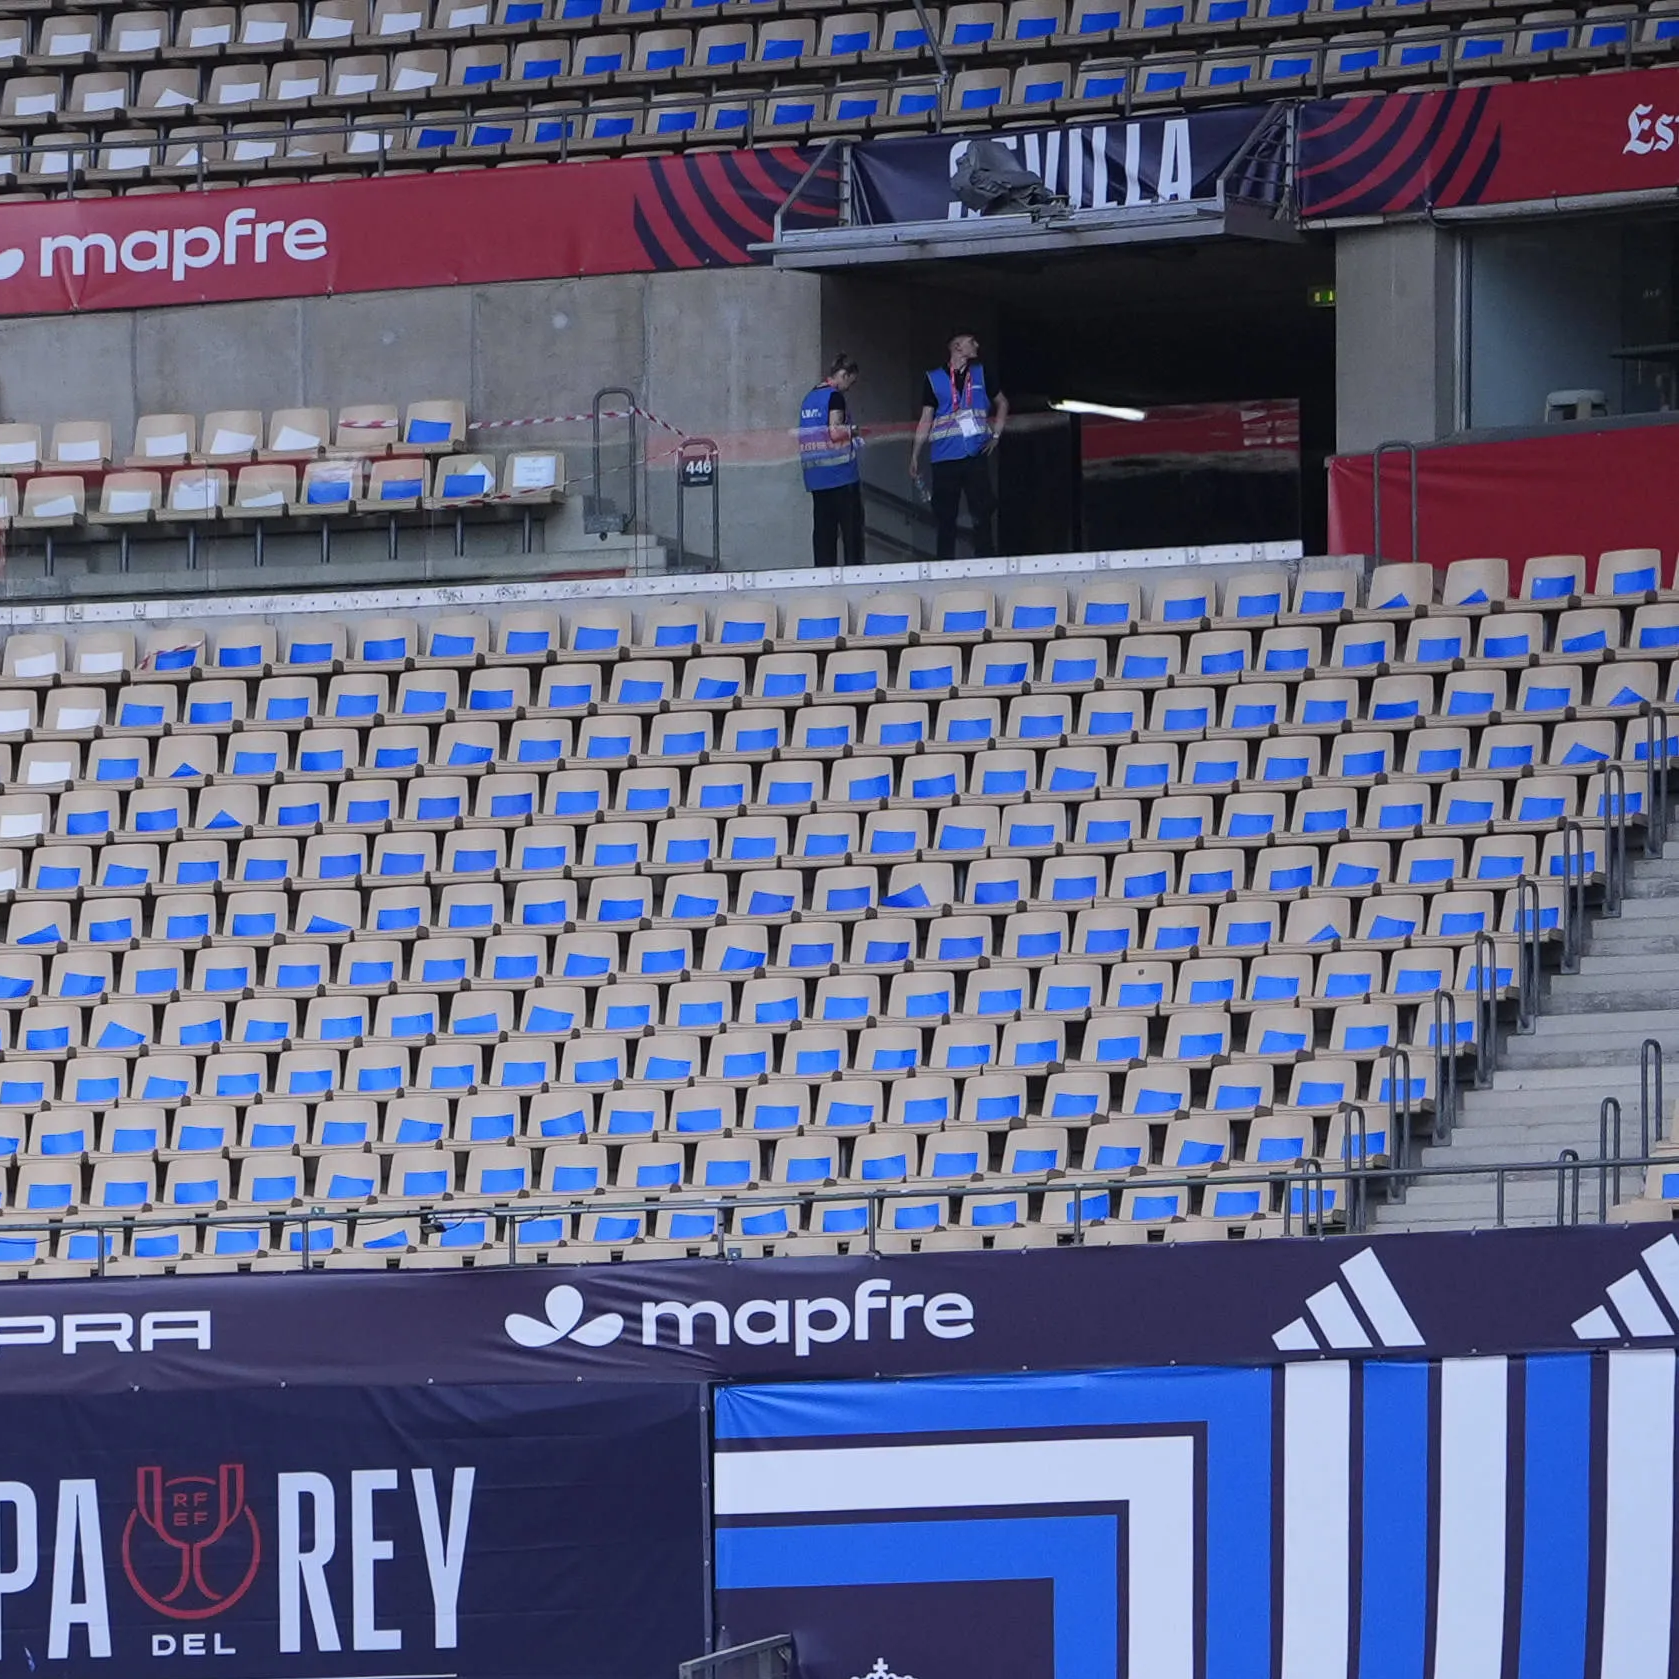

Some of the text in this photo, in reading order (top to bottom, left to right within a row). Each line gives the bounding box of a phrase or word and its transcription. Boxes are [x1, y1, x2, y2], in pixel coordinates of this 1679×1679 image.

[1622, 103, 1679, 155] Es
[39, 207, 327, 282] mapfre
[685, 460, 712, 475] 446
[641, 1278, 975, 1357] mapfre
[151, 1632, 236, 1657] DEL
[277, 1466, 476, 1653] REY
